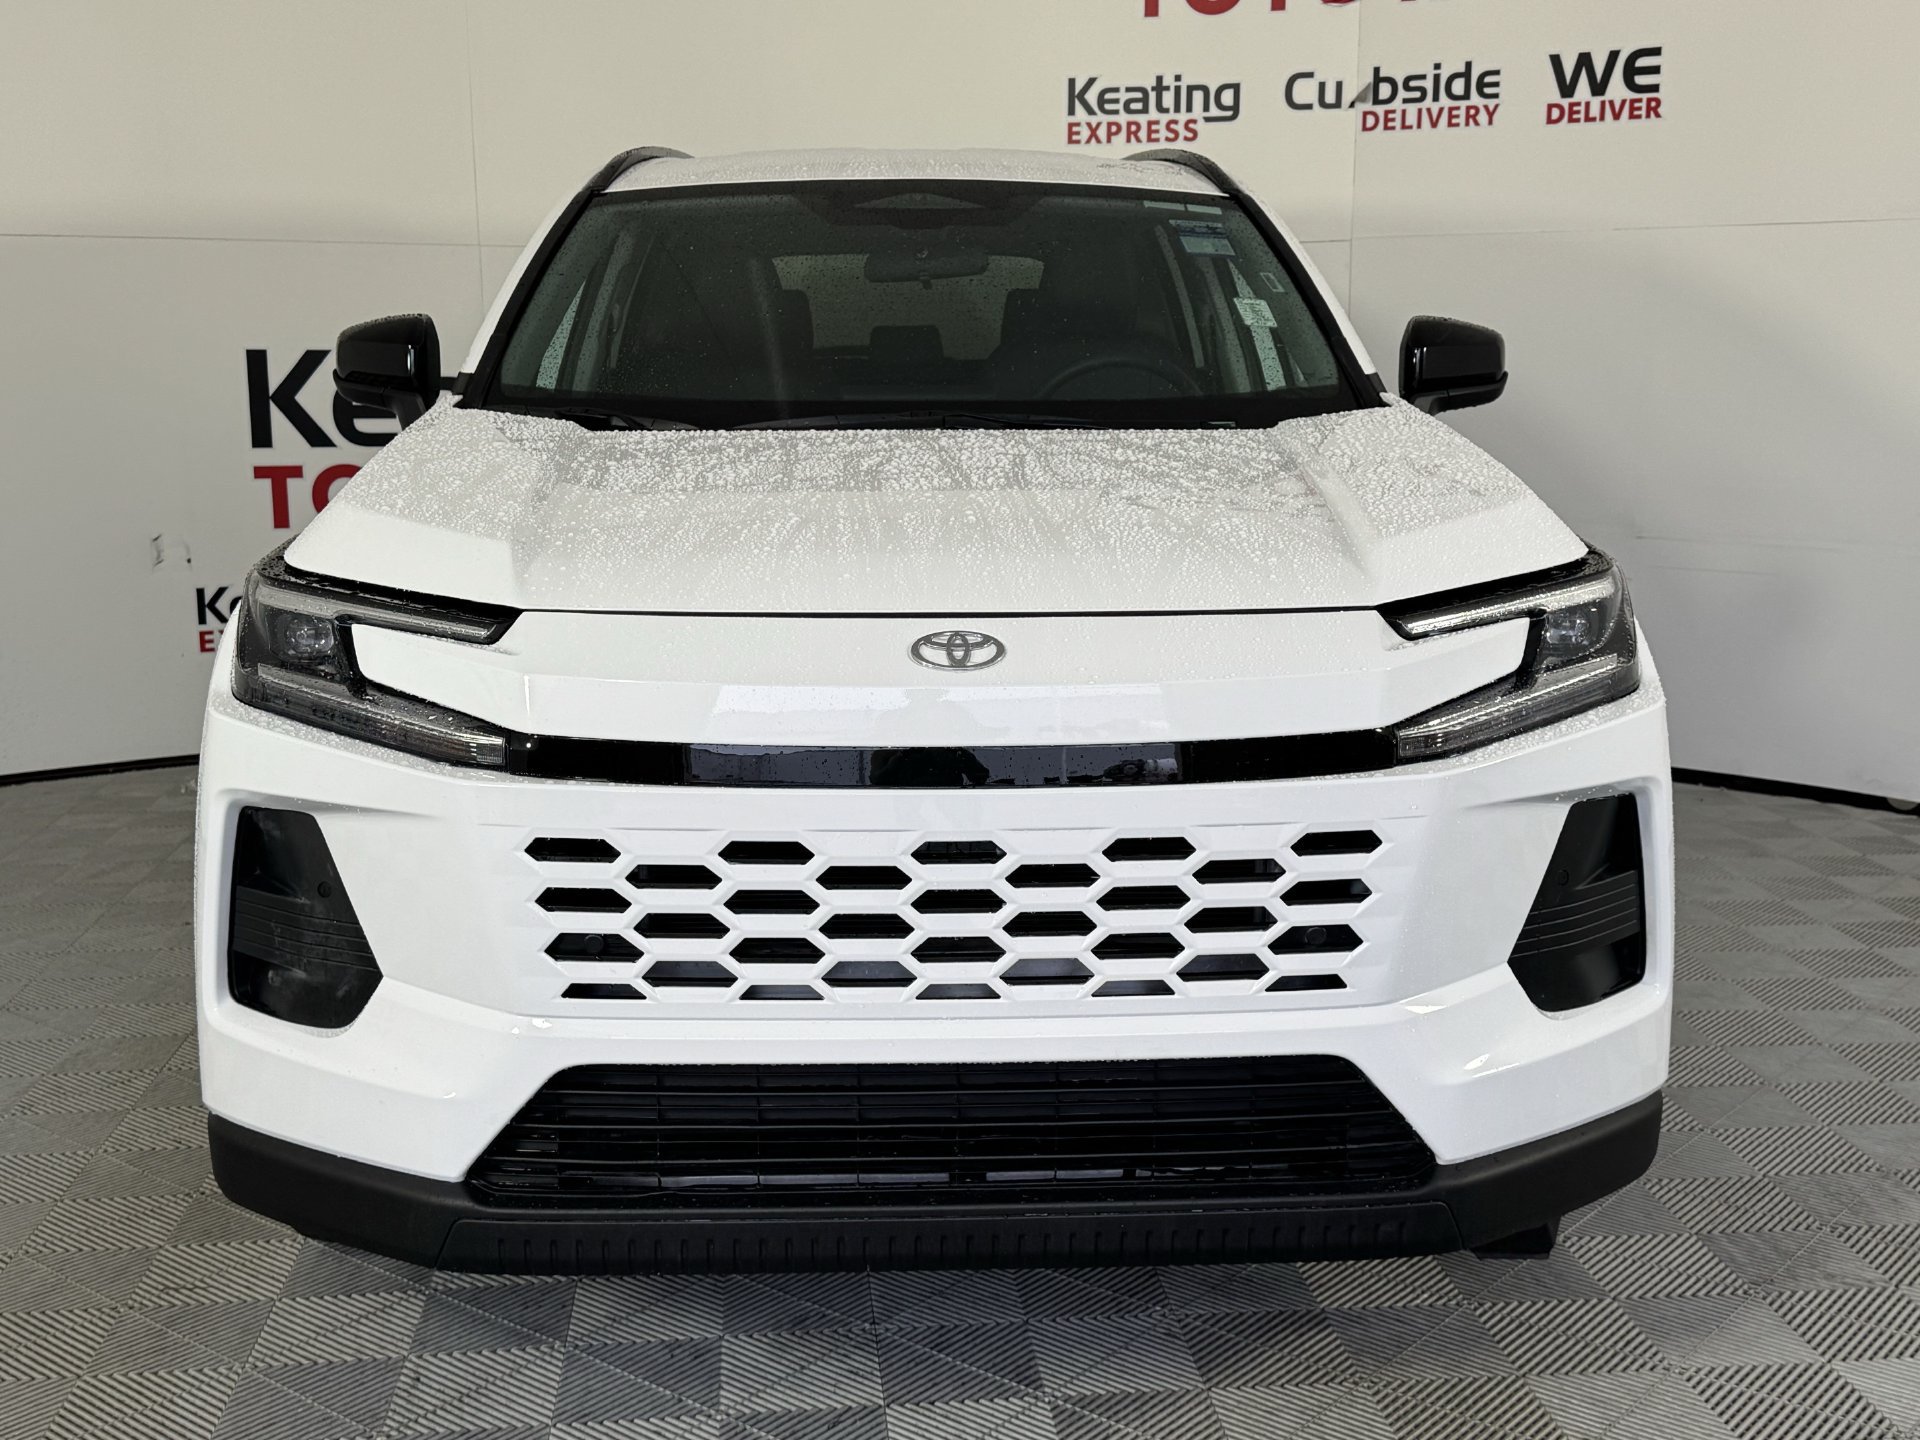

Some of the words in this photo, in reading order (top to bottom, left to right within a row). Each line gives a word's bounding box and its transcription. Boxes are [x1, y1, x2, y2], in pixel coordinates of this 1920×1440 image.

[1285, 60, 1501, 110] Cubside
[1548, 46, 1663, 99] WE
[1067, 74, 1241, 123] Keating
[1361, 103, 1500, 132] DELIVERY
[1545, 96, 1663, 125] DELIVER
[1067, 118, 1199, 145] EXPRESS
